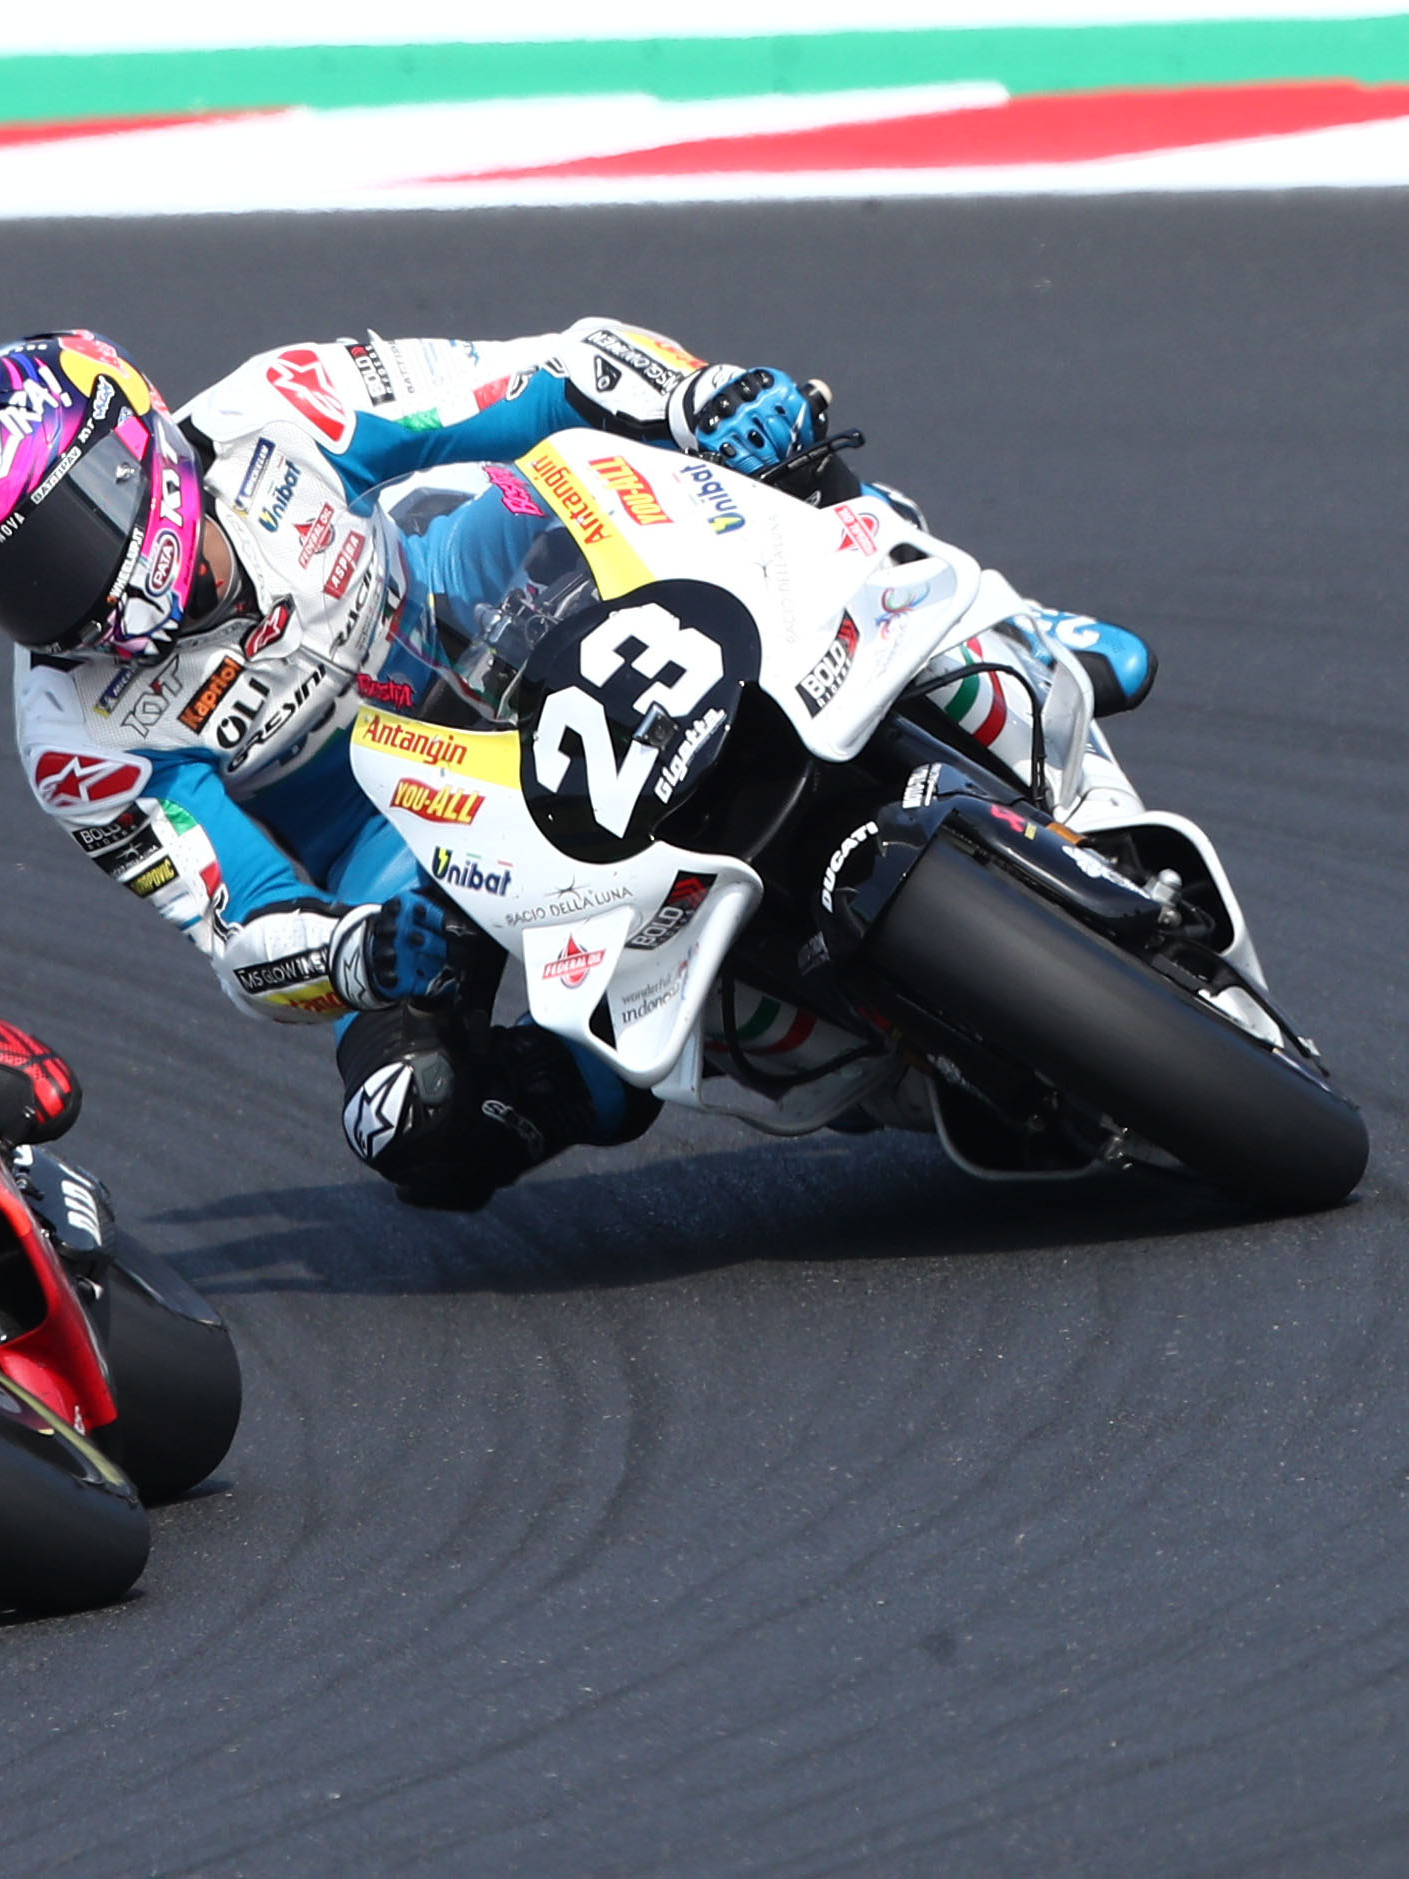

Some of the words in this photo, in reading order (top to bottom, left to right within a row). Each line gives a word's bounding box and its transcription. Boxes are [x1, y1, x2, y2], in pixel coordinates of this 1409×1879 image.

[258, 459, 302, 533] Unibat
[531, 454, 613, 546] Antangin
[681, 463, 746, 536] Unibat
[153, 545, 175, 586] PATA
[121, 653, 184, 739] KYT
[181, 656, 242, 732] Kapriol
[803, 638, 850, 696] BOLD
[227, 664, 327, 773] GRESINI
[365, 713, 468, 766] Antangin
[532, 601, 725, 840] 23
[432, 845, 512, 897] Unibat
[821, 821, 879, 914] DUCATI
[550, 897, 594, 918] DELLA
[594, 886, 634, 905] LUNA
[632, 906, 683, 946] BOLD
[265, 960, 299, 985] GLOW
[544, 953, 587, 977] FEDERAL
